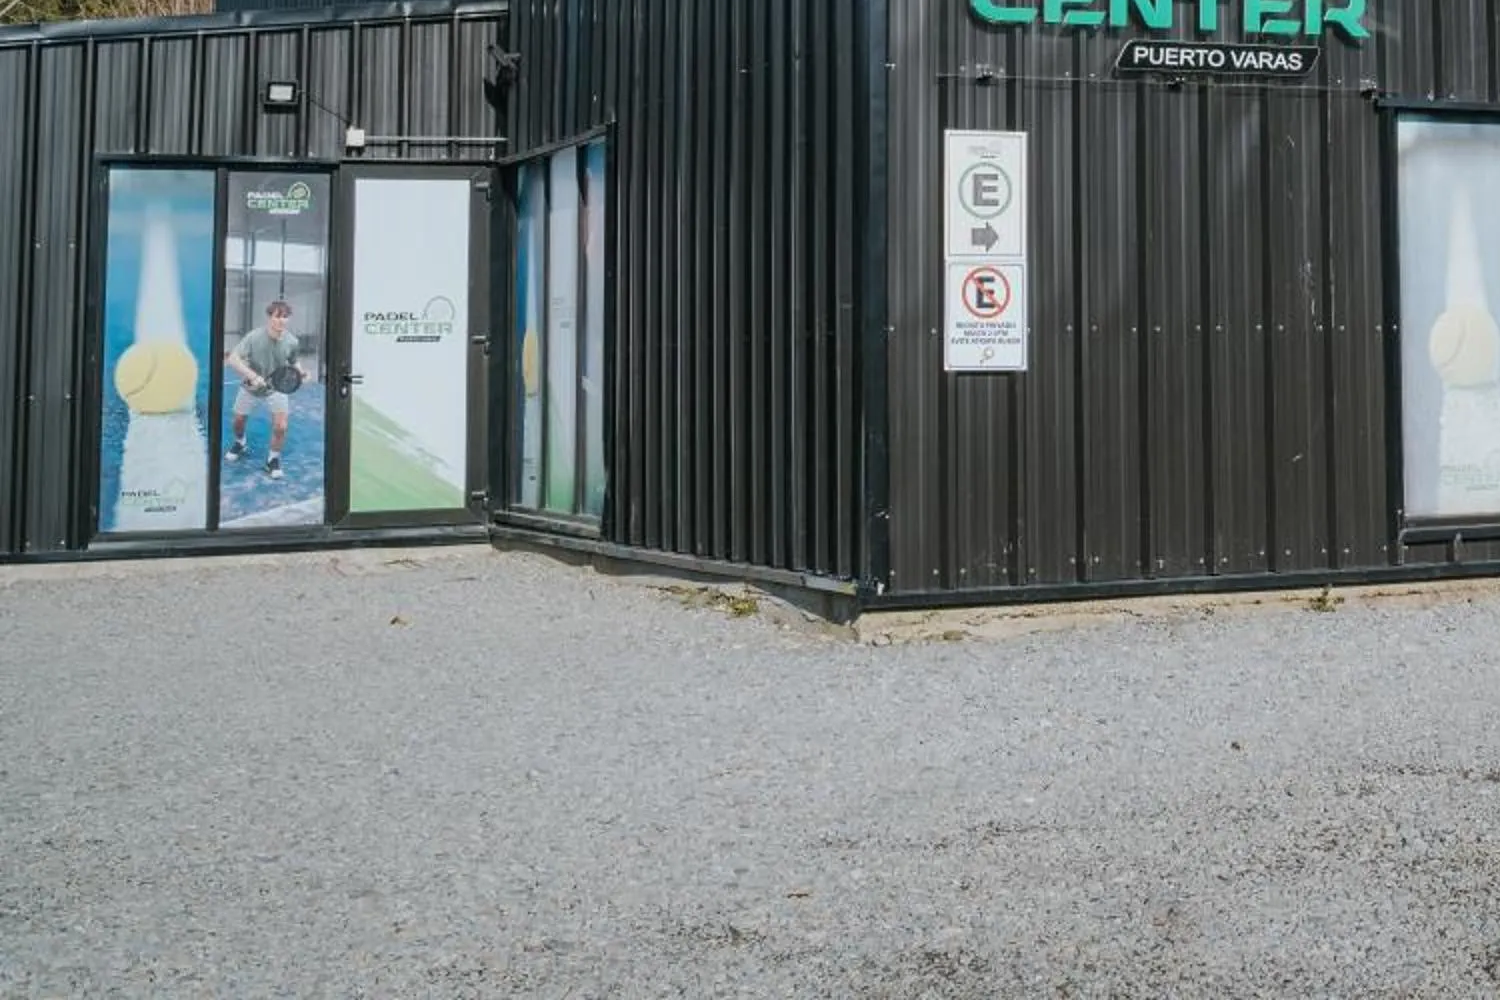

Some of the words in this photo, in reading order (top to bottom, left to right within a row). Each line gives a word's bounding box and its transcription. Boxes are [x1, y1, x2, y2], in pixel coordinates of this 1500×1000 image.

[1133, 46, 1225, 67] PUERTO
[1230, 51, 1303, 70] VARAS
[973, 174, 999, 206] E
[976, 276, 996, 308] E
[364, 311, 417, 321] PADEL
[364, 322, 453, 334] CENTER
